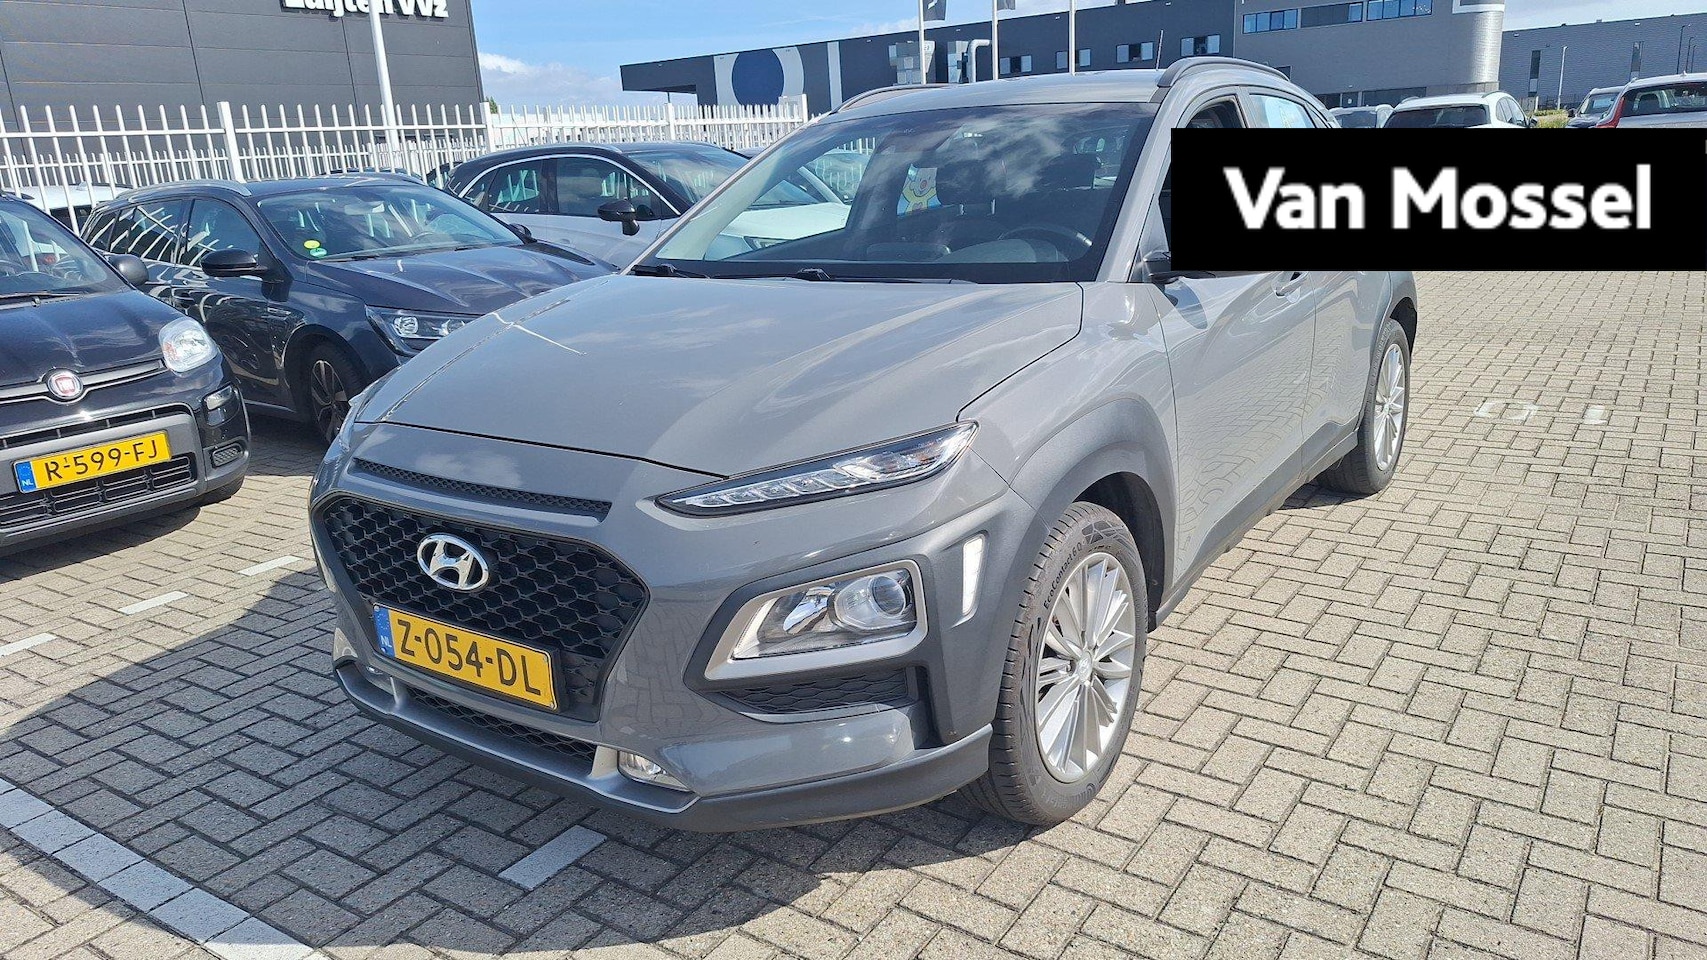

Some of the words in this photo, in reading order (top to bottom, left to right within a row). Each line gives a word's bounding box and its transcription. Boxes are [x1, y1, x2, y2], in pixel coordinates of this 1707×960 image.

[45, 440, 158, 482] R-599-FJ
[1043, 553, 1073, 610] EcoContact
[380, 634, 393, 648] NL
[397, 618, 542, 696] Z-054-DL
